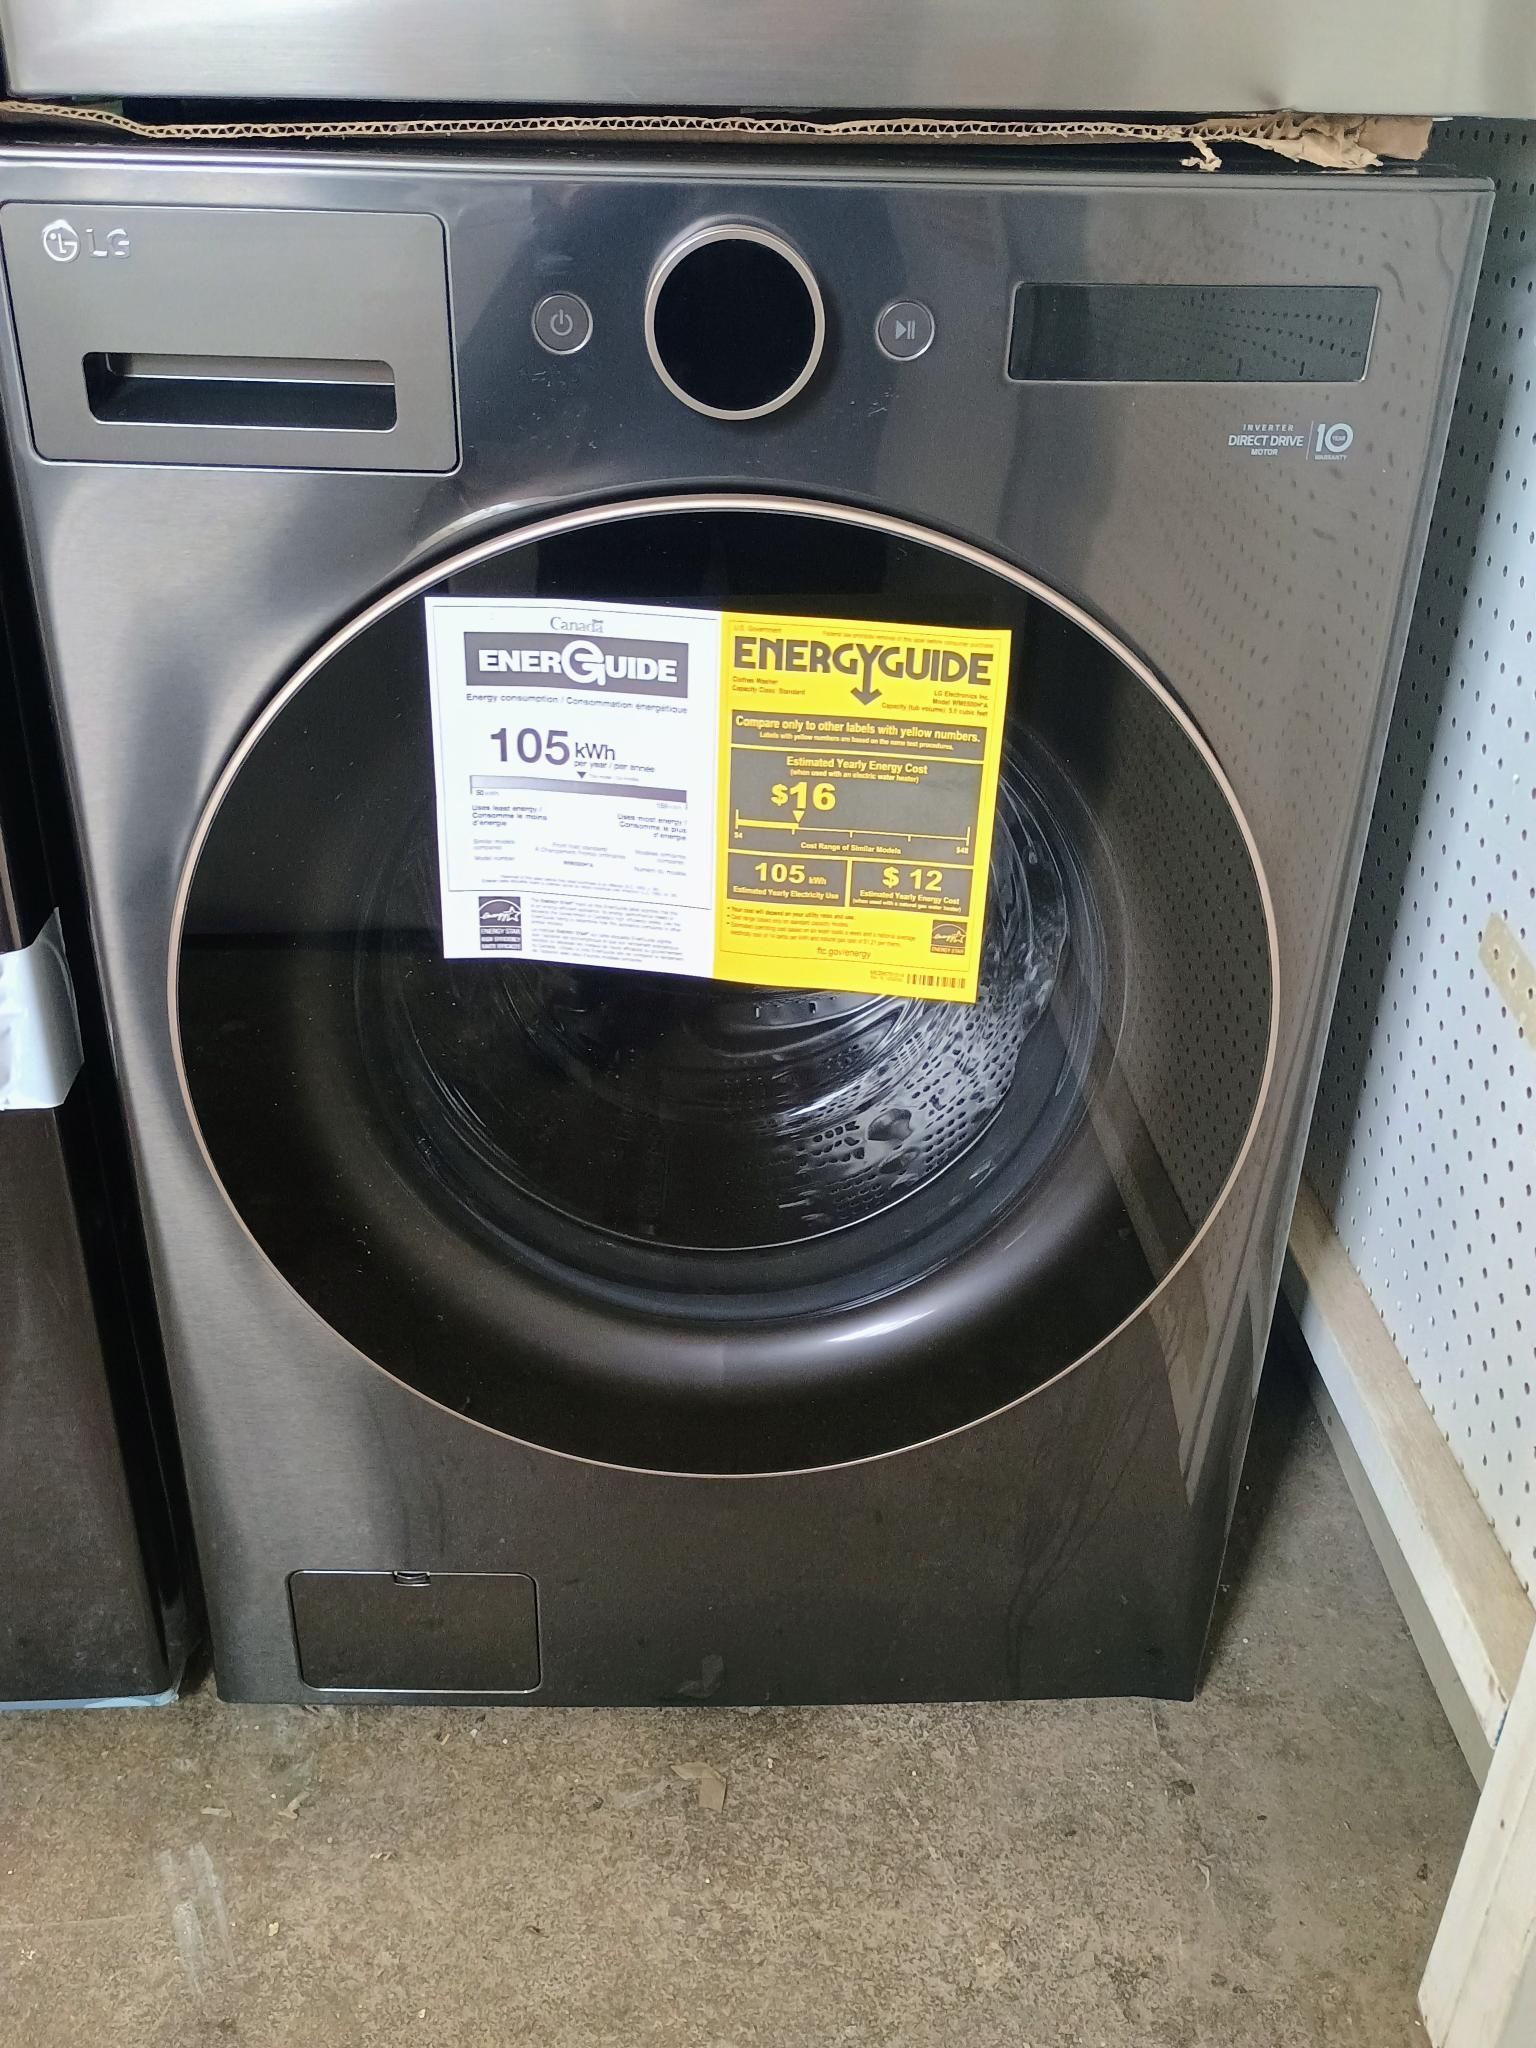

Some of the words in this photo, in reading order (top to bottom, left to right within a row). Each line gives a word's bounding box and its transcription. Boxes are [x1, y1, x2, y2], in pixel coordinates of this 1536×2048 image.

[86, 227, 130, 258] LG
[1243, 423, 1294, 432] INVERTER
[1228, 434, 1269, 446] DIRECT
[1270, 435, 1304, 447] DRIVE
[1251, 448, 1278, 456] MOTOR
[550, 616, 604, 633] Canada
[478, 640, 678, 686] ENERGUIDE
[734, 635, 994, 691] ENERGYGUIDE
[466, 694, 497, 703] Energy
[500, 695, 558, 703] consumption
[944, 690, 977, 700] Electronics
[882, 702, 906, 711] Capacity
[735, 715, 781, 730] Compare
[782, 720, 804, 732] only
[806, 720, 816, 731] to
[818, 720, 844, 732] other
[846, 722, 876, 734] labels
[877, 724, 899, 736] with
[900, 726, 933, 739] yellow
[934, 730, 981, 743] numbers.
[780, 732, 793, 740] with
[794, 734, 813, 742] yellow
[490, 727, 570, 765] 105
[575, 742, 616, 761] kWh
[786, 756, 835, 768] Estimated
[836, 758, 868, 772] Yearly
[868, 760, 903, 774] Energy
[904, 762, 929, 775] Cost
[852, 772, 877, 780] electric
[770, 782, 836, 811] $16
[818, 843, 841, 852] Range
[851, 845, 876, 853] Similar
[876, 846, 902, 855] Models
[755, 862, 806, 884] 105
[882, 866, 900, 889] $
[910, 868, 943, 892] 12
[732, 885, 767, 896] Estimated
[768, 888, 790, 899] Yearly
[790, 890, 825, 900] Electricity
[825, 892, 839, 900] Use
[860, 890, 894, 899] Estimated
[895, 892, 917, 902] Yearly
[918, 894, 942, 905] Energy
[943, 896, 960, 905] Cost
